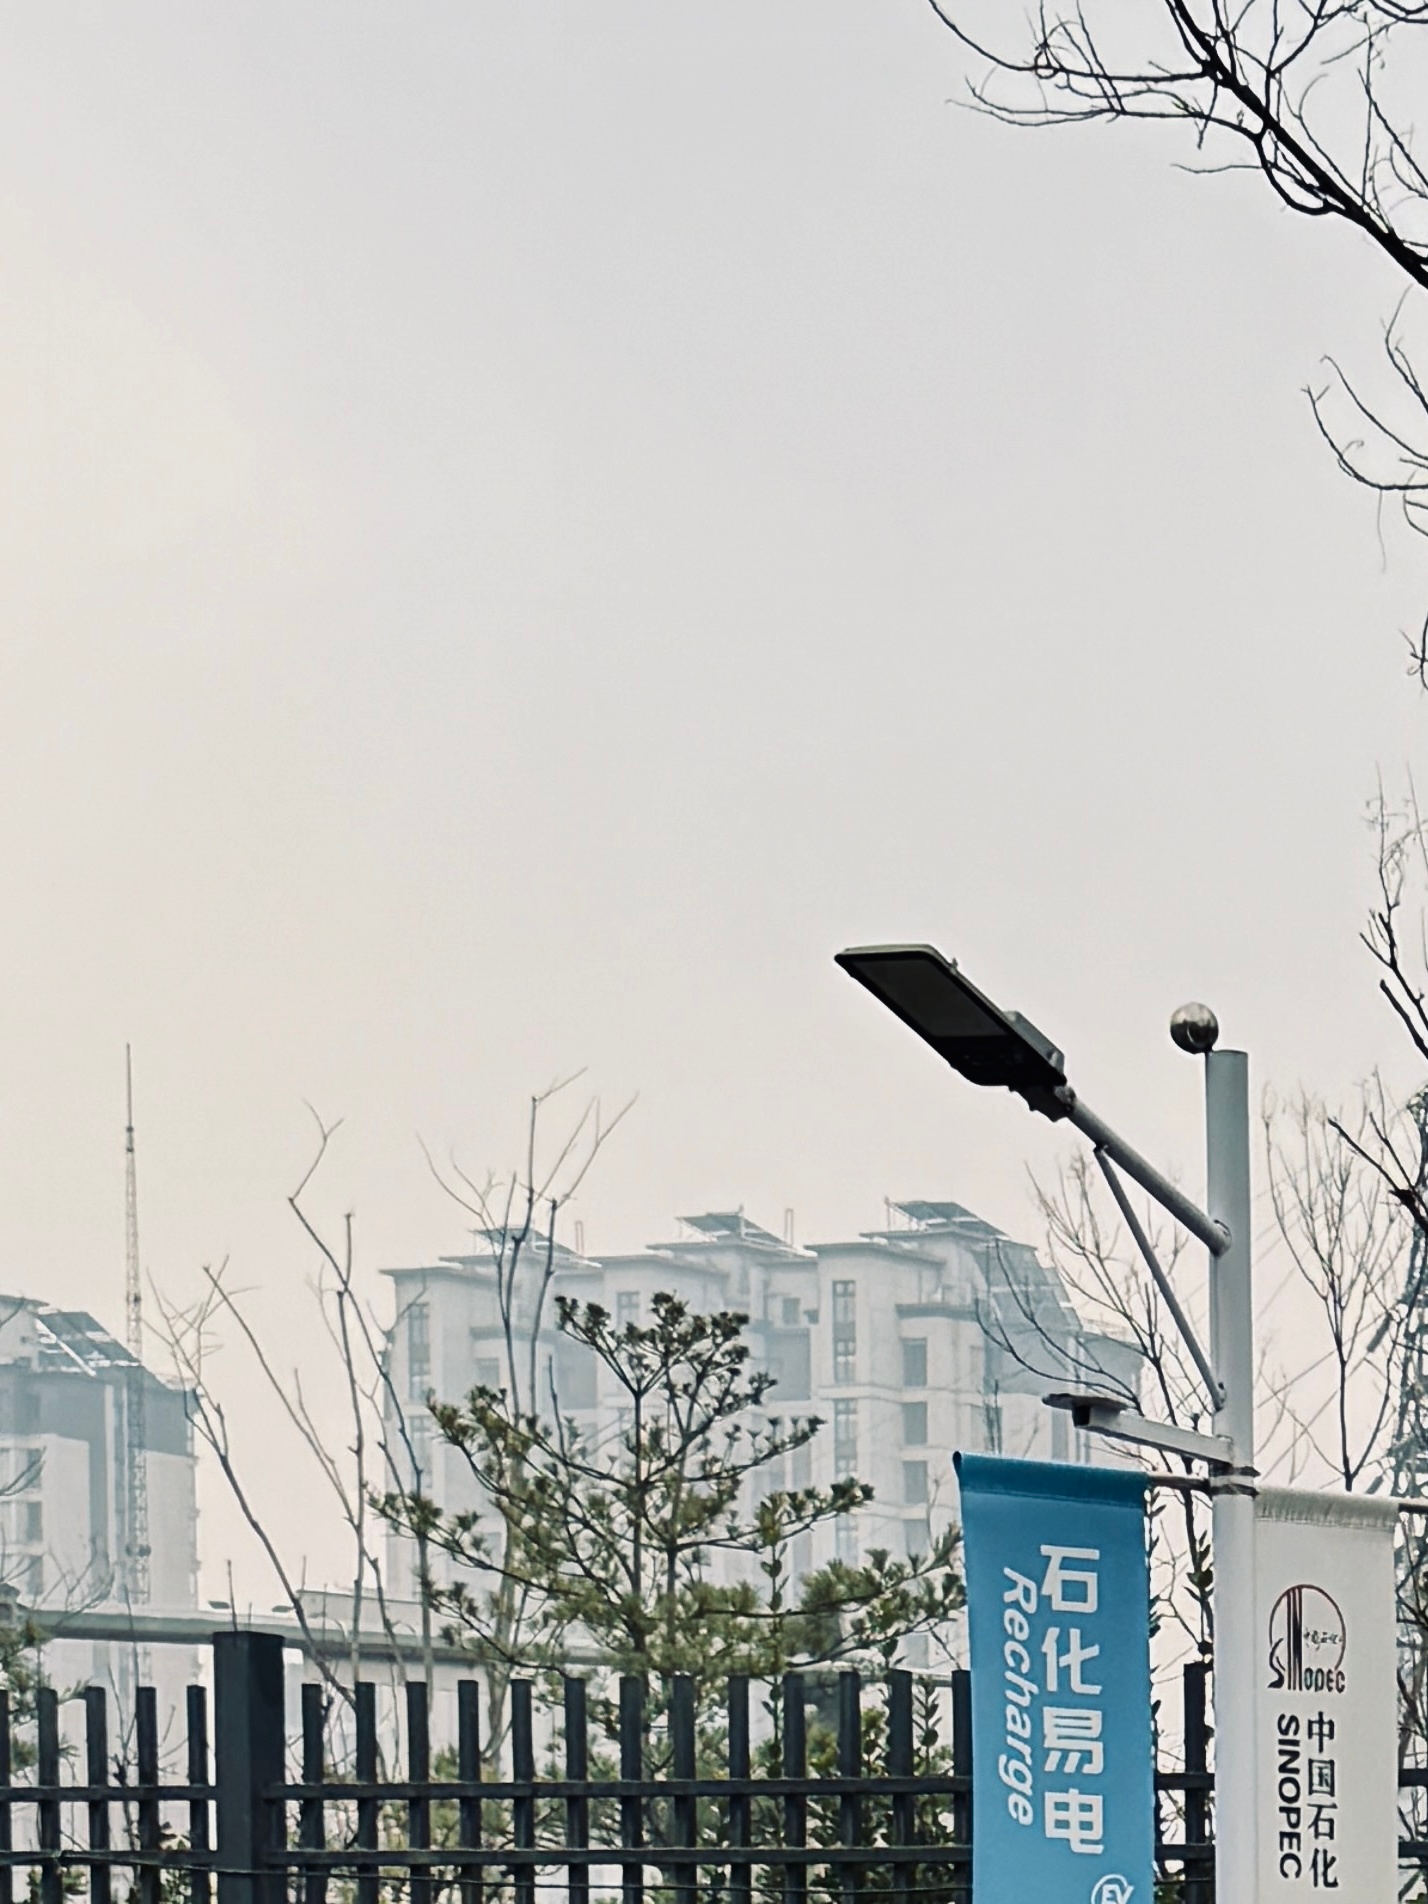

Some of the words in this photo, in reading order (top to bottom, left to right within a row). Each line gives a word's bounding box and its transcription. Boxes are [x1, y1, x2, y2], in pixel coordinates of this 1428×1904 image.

[1000, 1567, 1038, 1826] Recharge
[1040, 1545, 1104, 1855] 石化易电
[1277, 1714, 1302, 1880] SINOPEC
[1307, 1711, 1339, 1889] 中国石化
